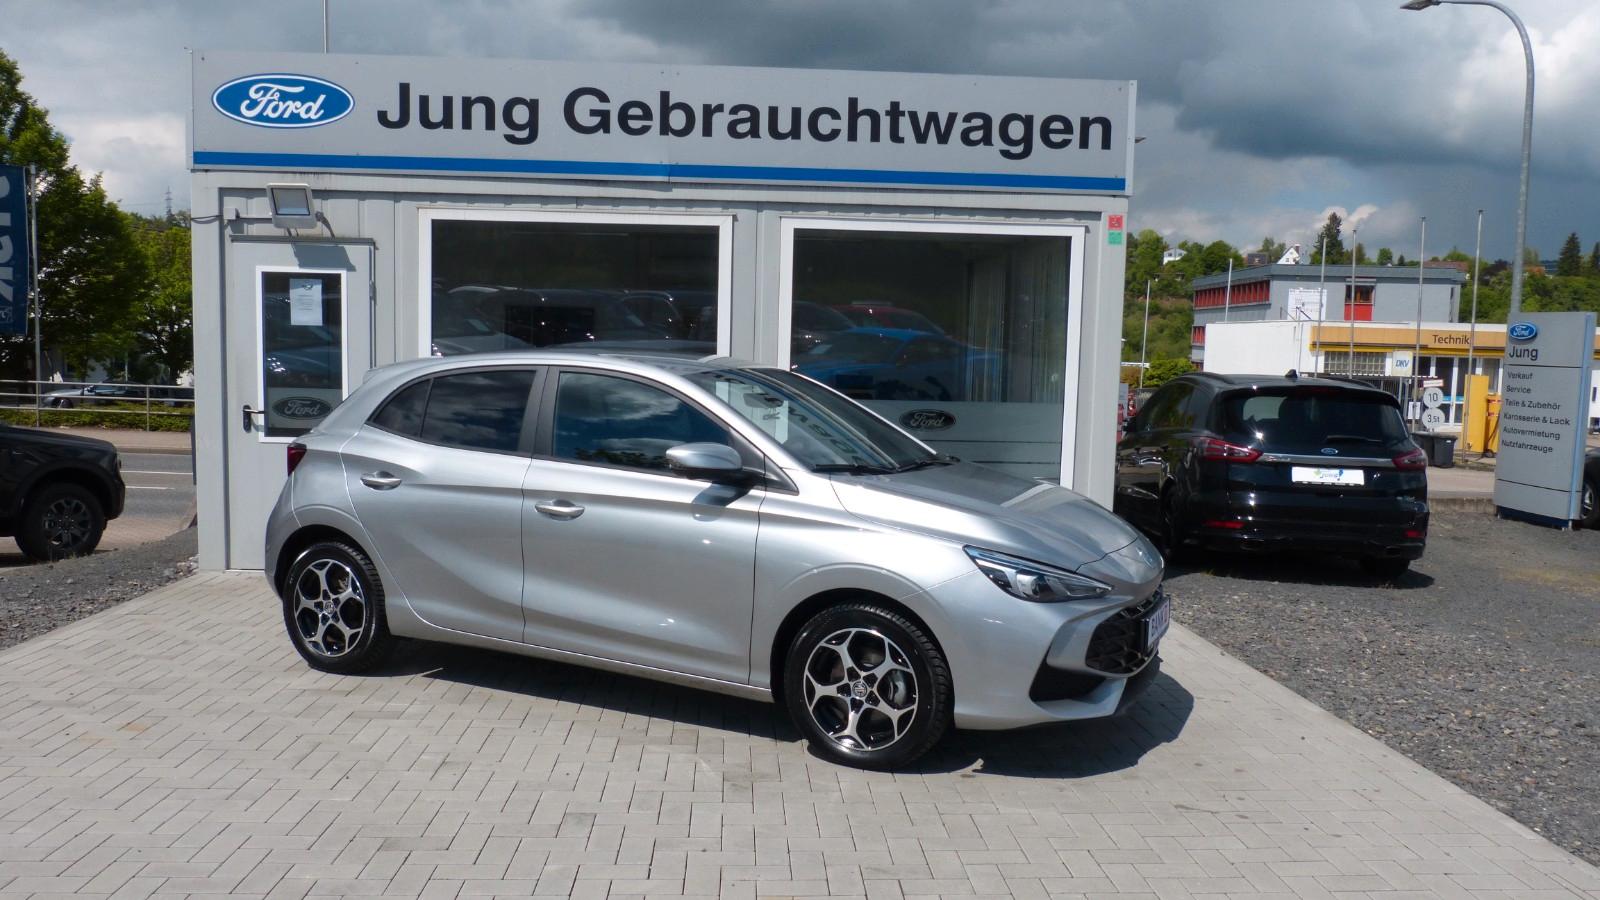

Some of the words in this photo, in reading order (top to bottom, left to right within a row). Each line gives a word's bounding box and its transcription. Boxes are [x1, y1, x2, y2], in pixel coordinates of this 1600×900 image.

[239, 83, 326, 120] Ford
[377, 82, 540, 145] Jung
[563, 87, 1112, 160] Gebrauchtwagen
[1432, 334, 1470, 345] Technik
[1509, 346, 1538, 361] Jung
[1395, 359, 1409, 368] DKV
[1507, 371, 1533, 380] Verkauf
[1506, 385, 1531, 394] Service
[1428, 392, 1438, 403] 10
[1505, 399, 1520, 407] Teile
[1521, 400, 1527, 408] &
[1527, 400, 1561, 410] Zubehör
[283, 400, 321, 416] Ford
[910, 412, 945, 427] Ford
[1503, 412, 1541, 423] Karosserie
[1541, 416, 1548, 424] &
[1549, 417, 1571, 426] Lack
[1503, 426, 1561, 440] Autovermietung
[1501, 439, 1554, 453] Nutzfahrzeuge
